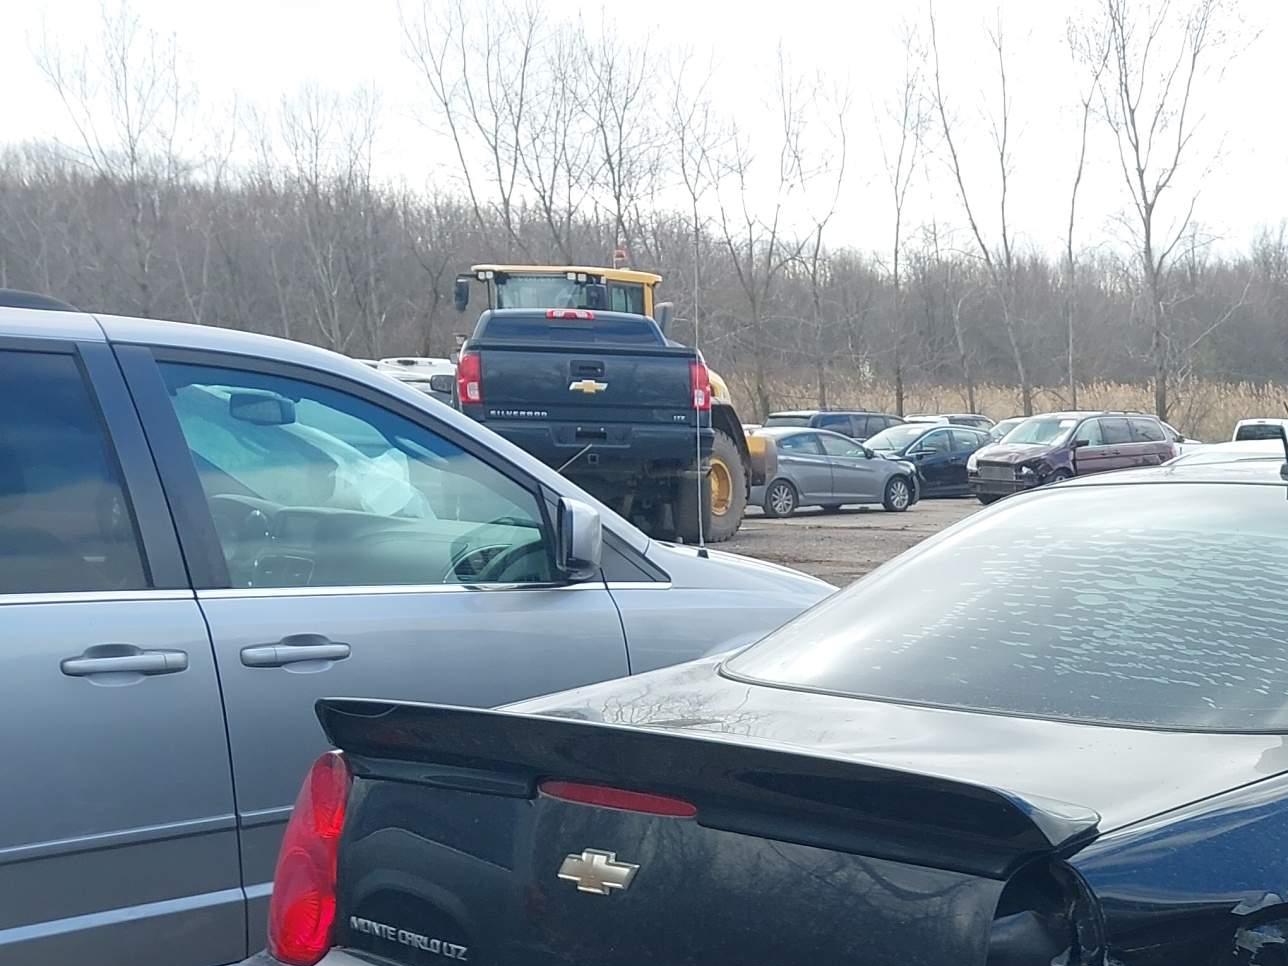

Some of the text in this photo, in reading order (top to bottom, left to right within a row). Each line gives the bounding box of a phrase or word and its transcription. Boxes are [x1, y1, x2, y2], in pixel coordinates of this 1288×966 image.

[350, 916, 468, 961] MONTE CARLO LTZ
